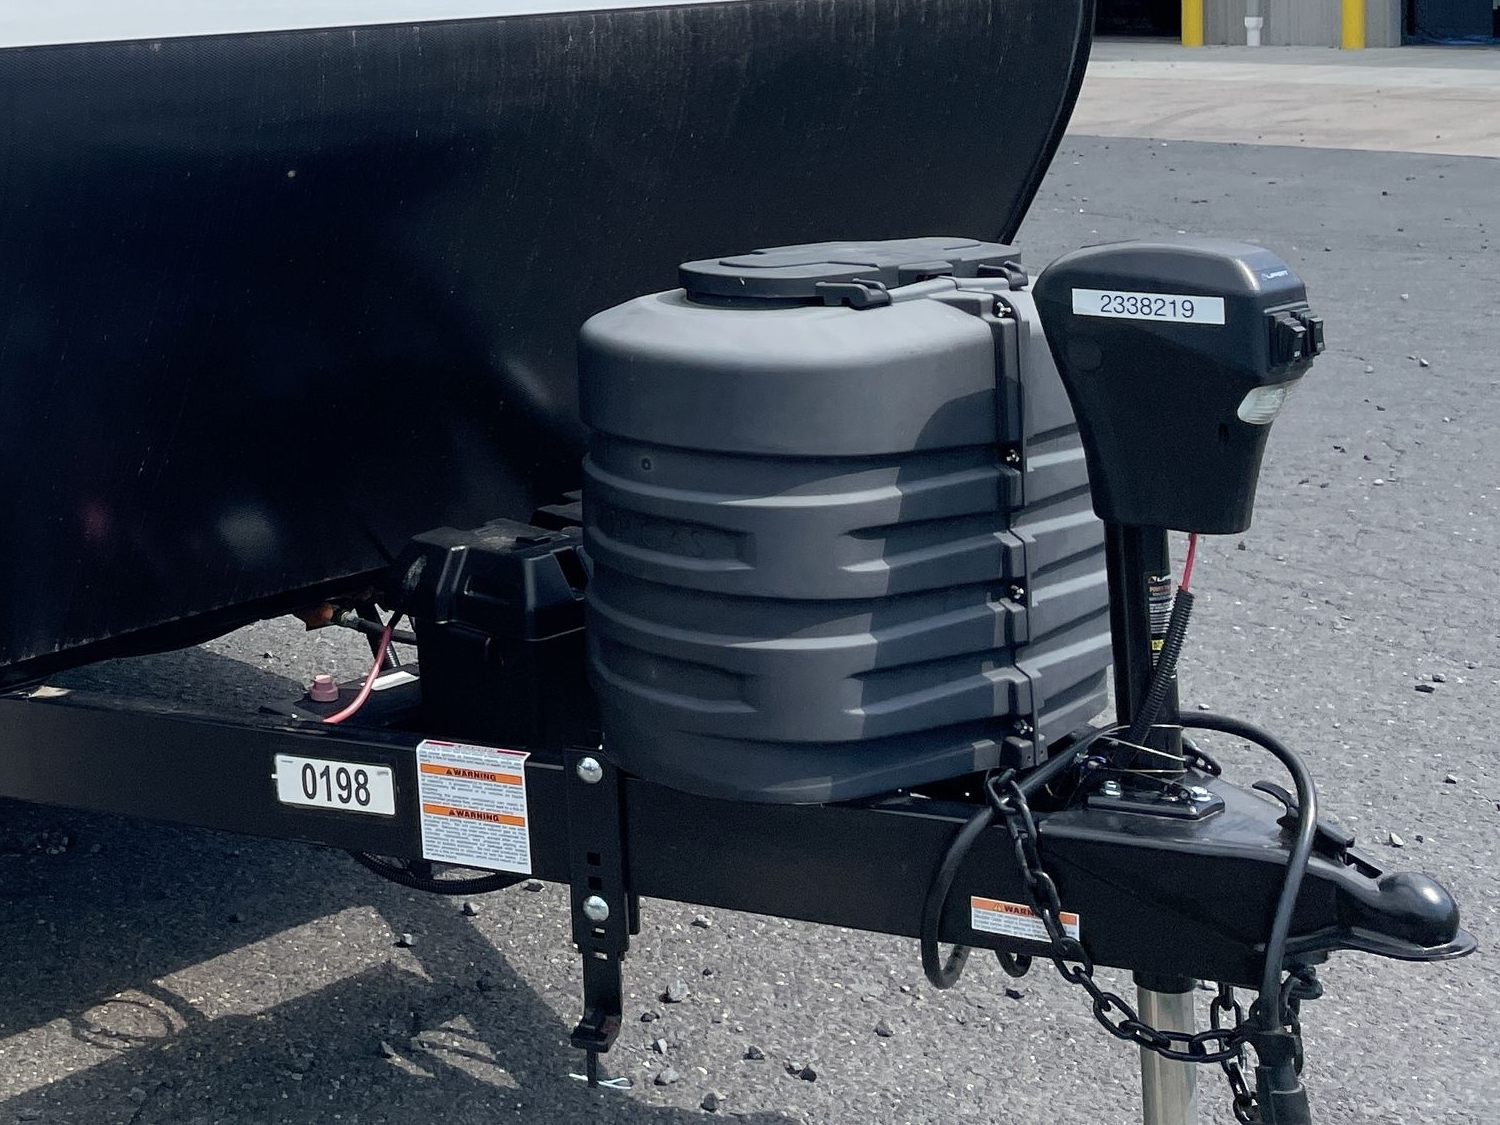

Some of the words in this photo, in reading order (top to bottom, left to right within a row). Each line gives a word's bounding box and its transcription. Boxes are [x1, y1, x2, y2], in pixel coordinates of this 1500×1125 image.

[1100, 294, 1195, 319] 2338219
[301, 762, 371, 807] 0198
[452, 768, 497, 782] WARNING
[456, 809, 500, 822] WARNING
